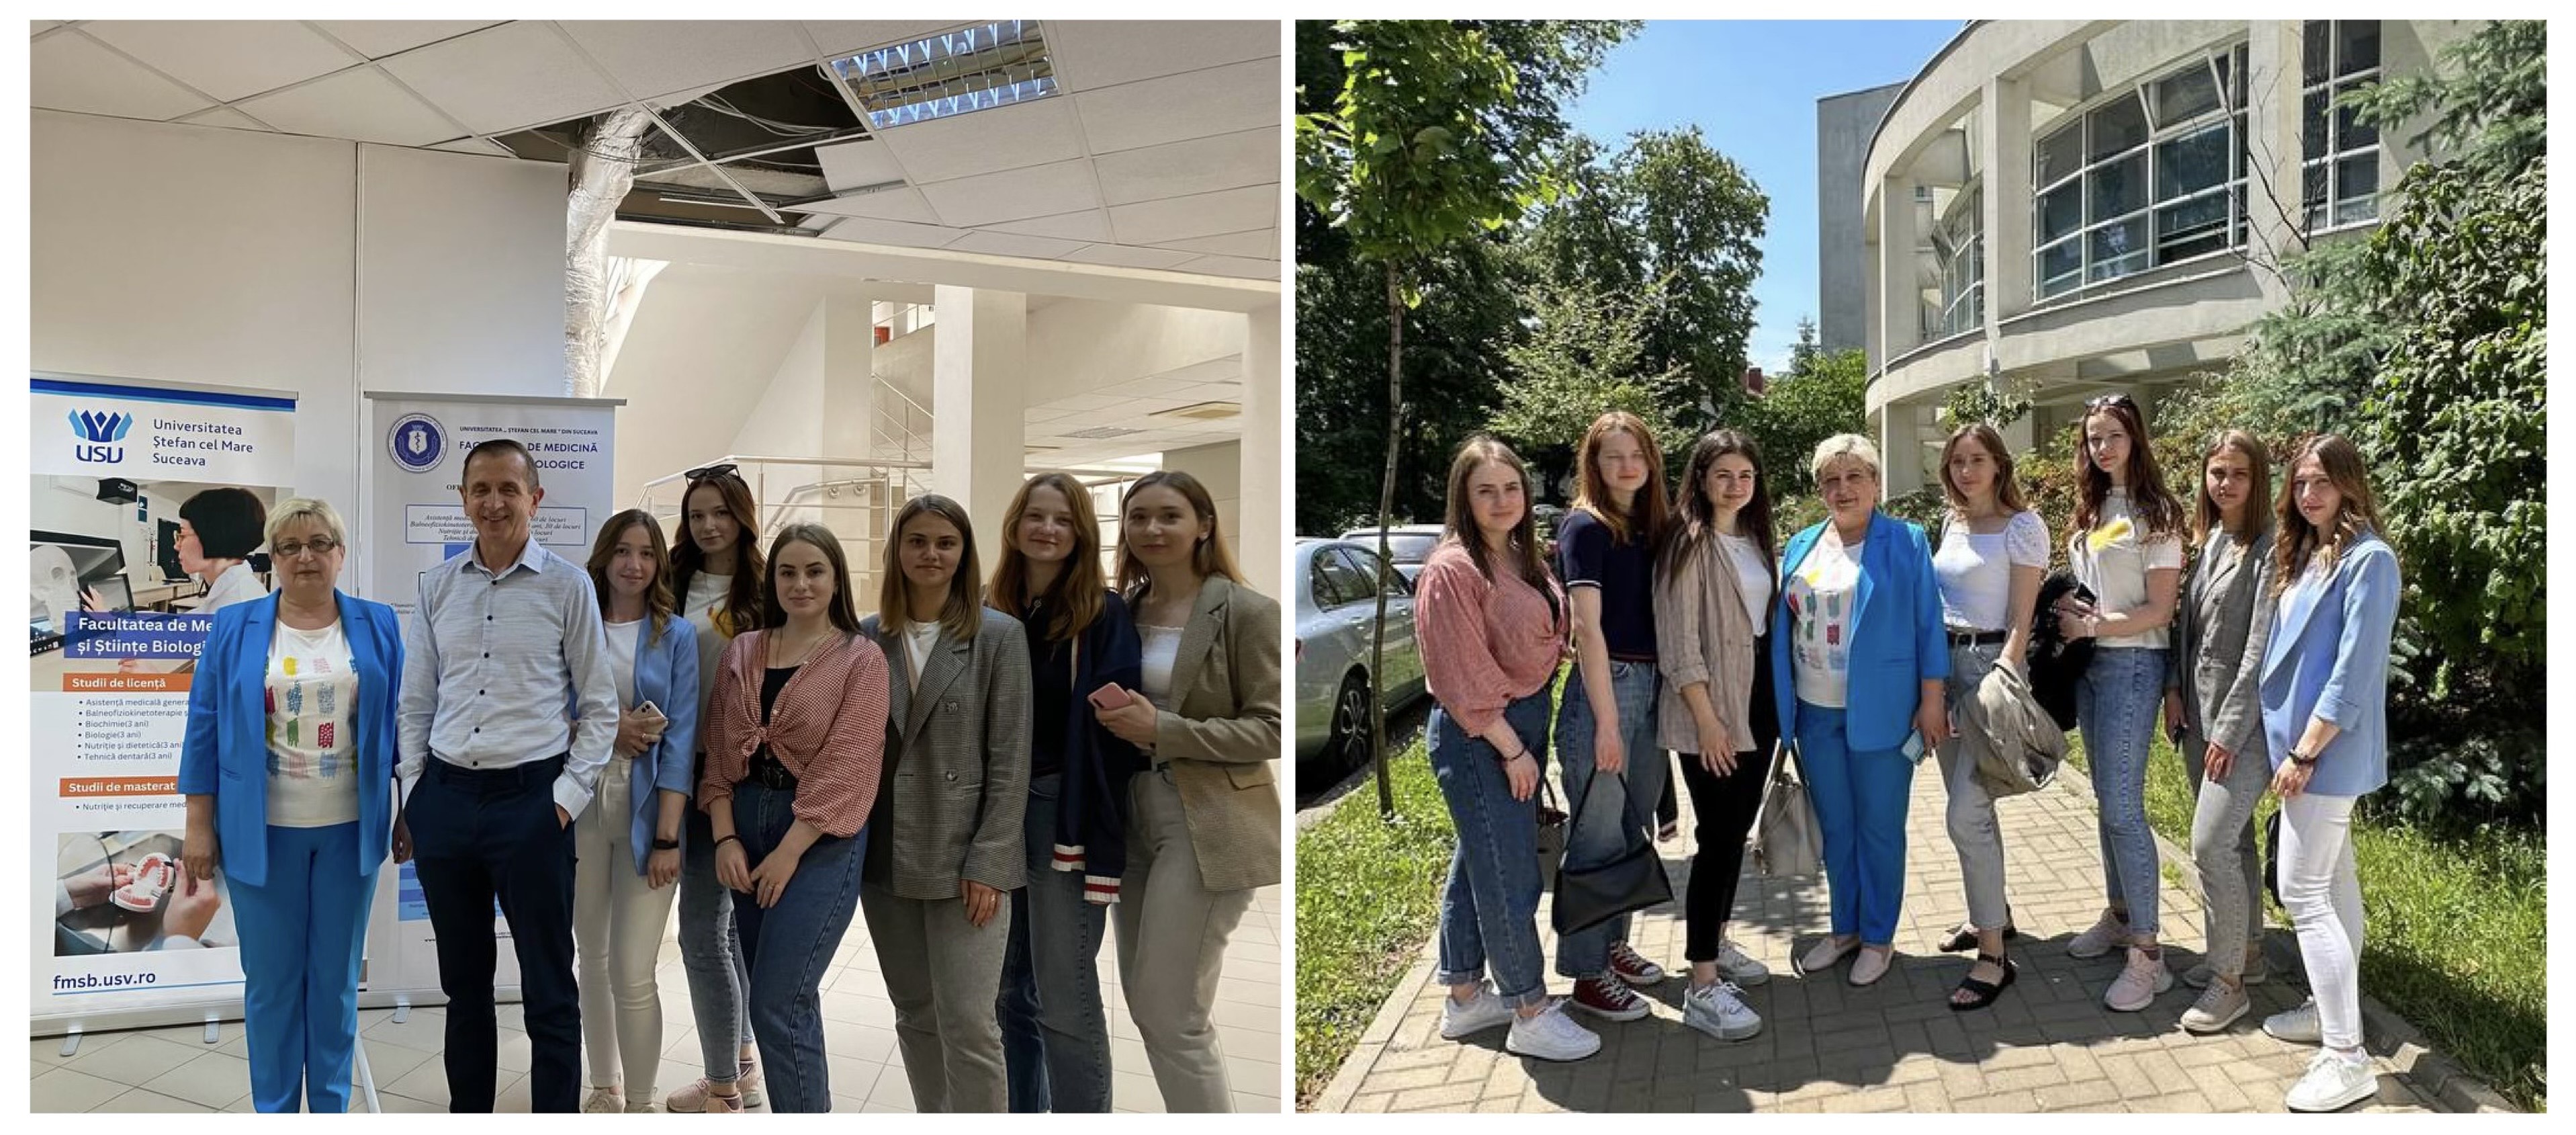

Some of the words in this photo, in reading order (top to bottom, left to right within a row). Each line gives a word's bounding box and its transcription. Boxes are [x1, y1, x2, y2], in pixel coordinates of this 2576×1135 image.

[153, 419, 242, 435] Universitatea
[153, 435, 195, 448] Ștefan
[199, 439, 218, 450] cel
[222, 440, 253, 452] Mare
[528, 442, 541, 451] DE
[544, 442, 598, 452] MEDICINĂ
[152, 453, 206, 466] Suceava
[535, 460, 585, 469] OLOGICE
[79, 618, 163, 632] Facultatea
[167, 619, 187, 632] de
[77, 640, 90, 655] și
[95, 640, 147, 656] Științe
[152, 640, 206, 656] Biologi
[72, 678, 106, 688] Studii
[109, 678, 124, 688] de
[127, 678, 166, 690] licență
[69, 783, 103, 792] Studii
[106, 782, 120, 792] de
[124, 782, 175, 792] masterat
[53, 973, 156, 989] fmsb.usv.ro
